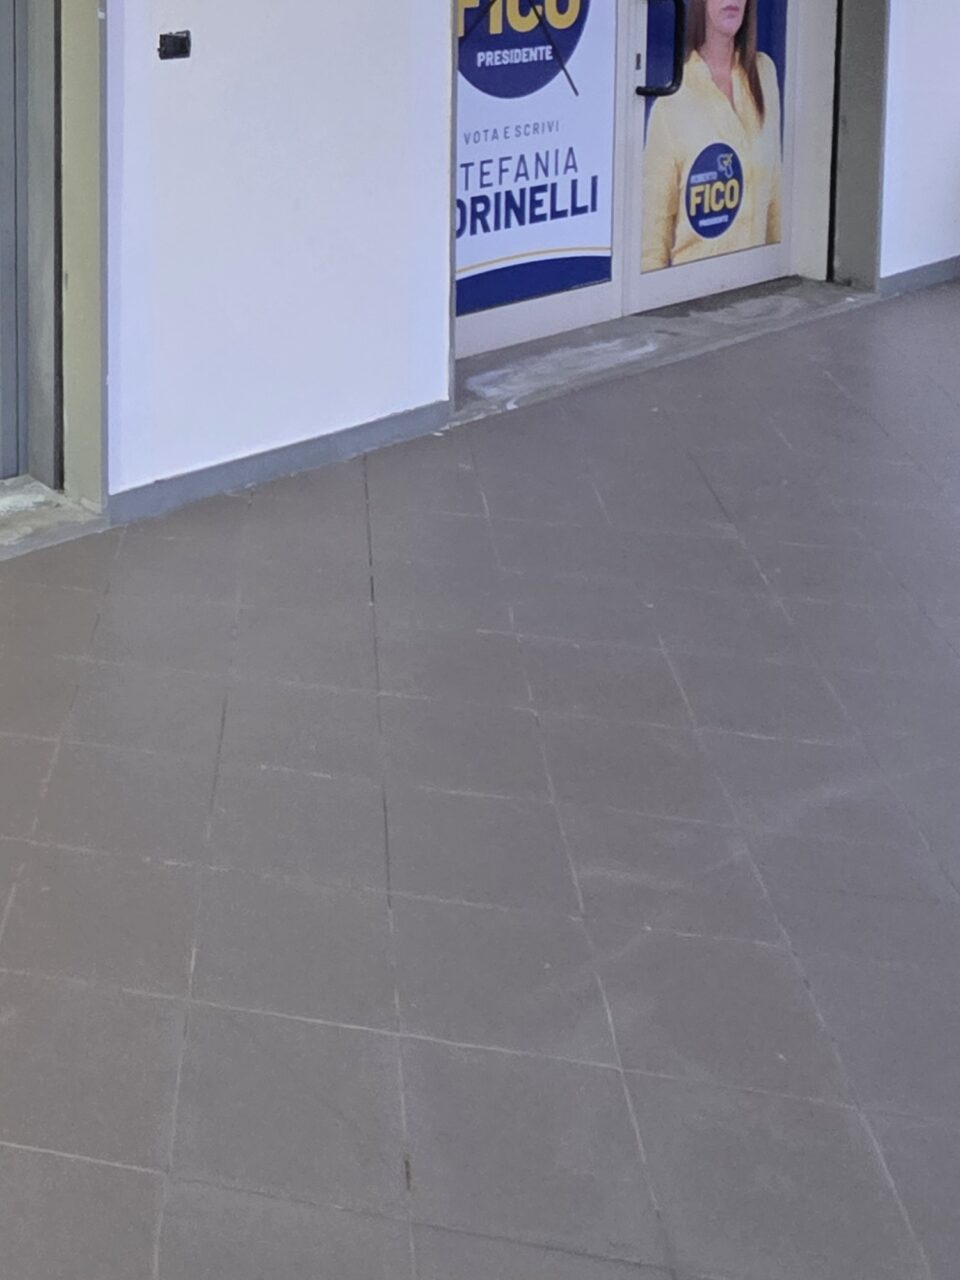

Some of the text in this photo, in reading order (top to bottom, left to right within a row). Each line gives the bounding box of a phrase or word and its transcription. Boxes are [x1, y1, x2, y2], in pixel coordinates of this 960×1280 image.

[476, 45, 554, 68] PRESIDENTE
[463, 120, 560, 145] VOTA E SCRIVI
[459, 146, 579, 192] TEFANIA
[455, 174, 599, 240] ORINELLI
[689, 178, 740, 217] FICO
